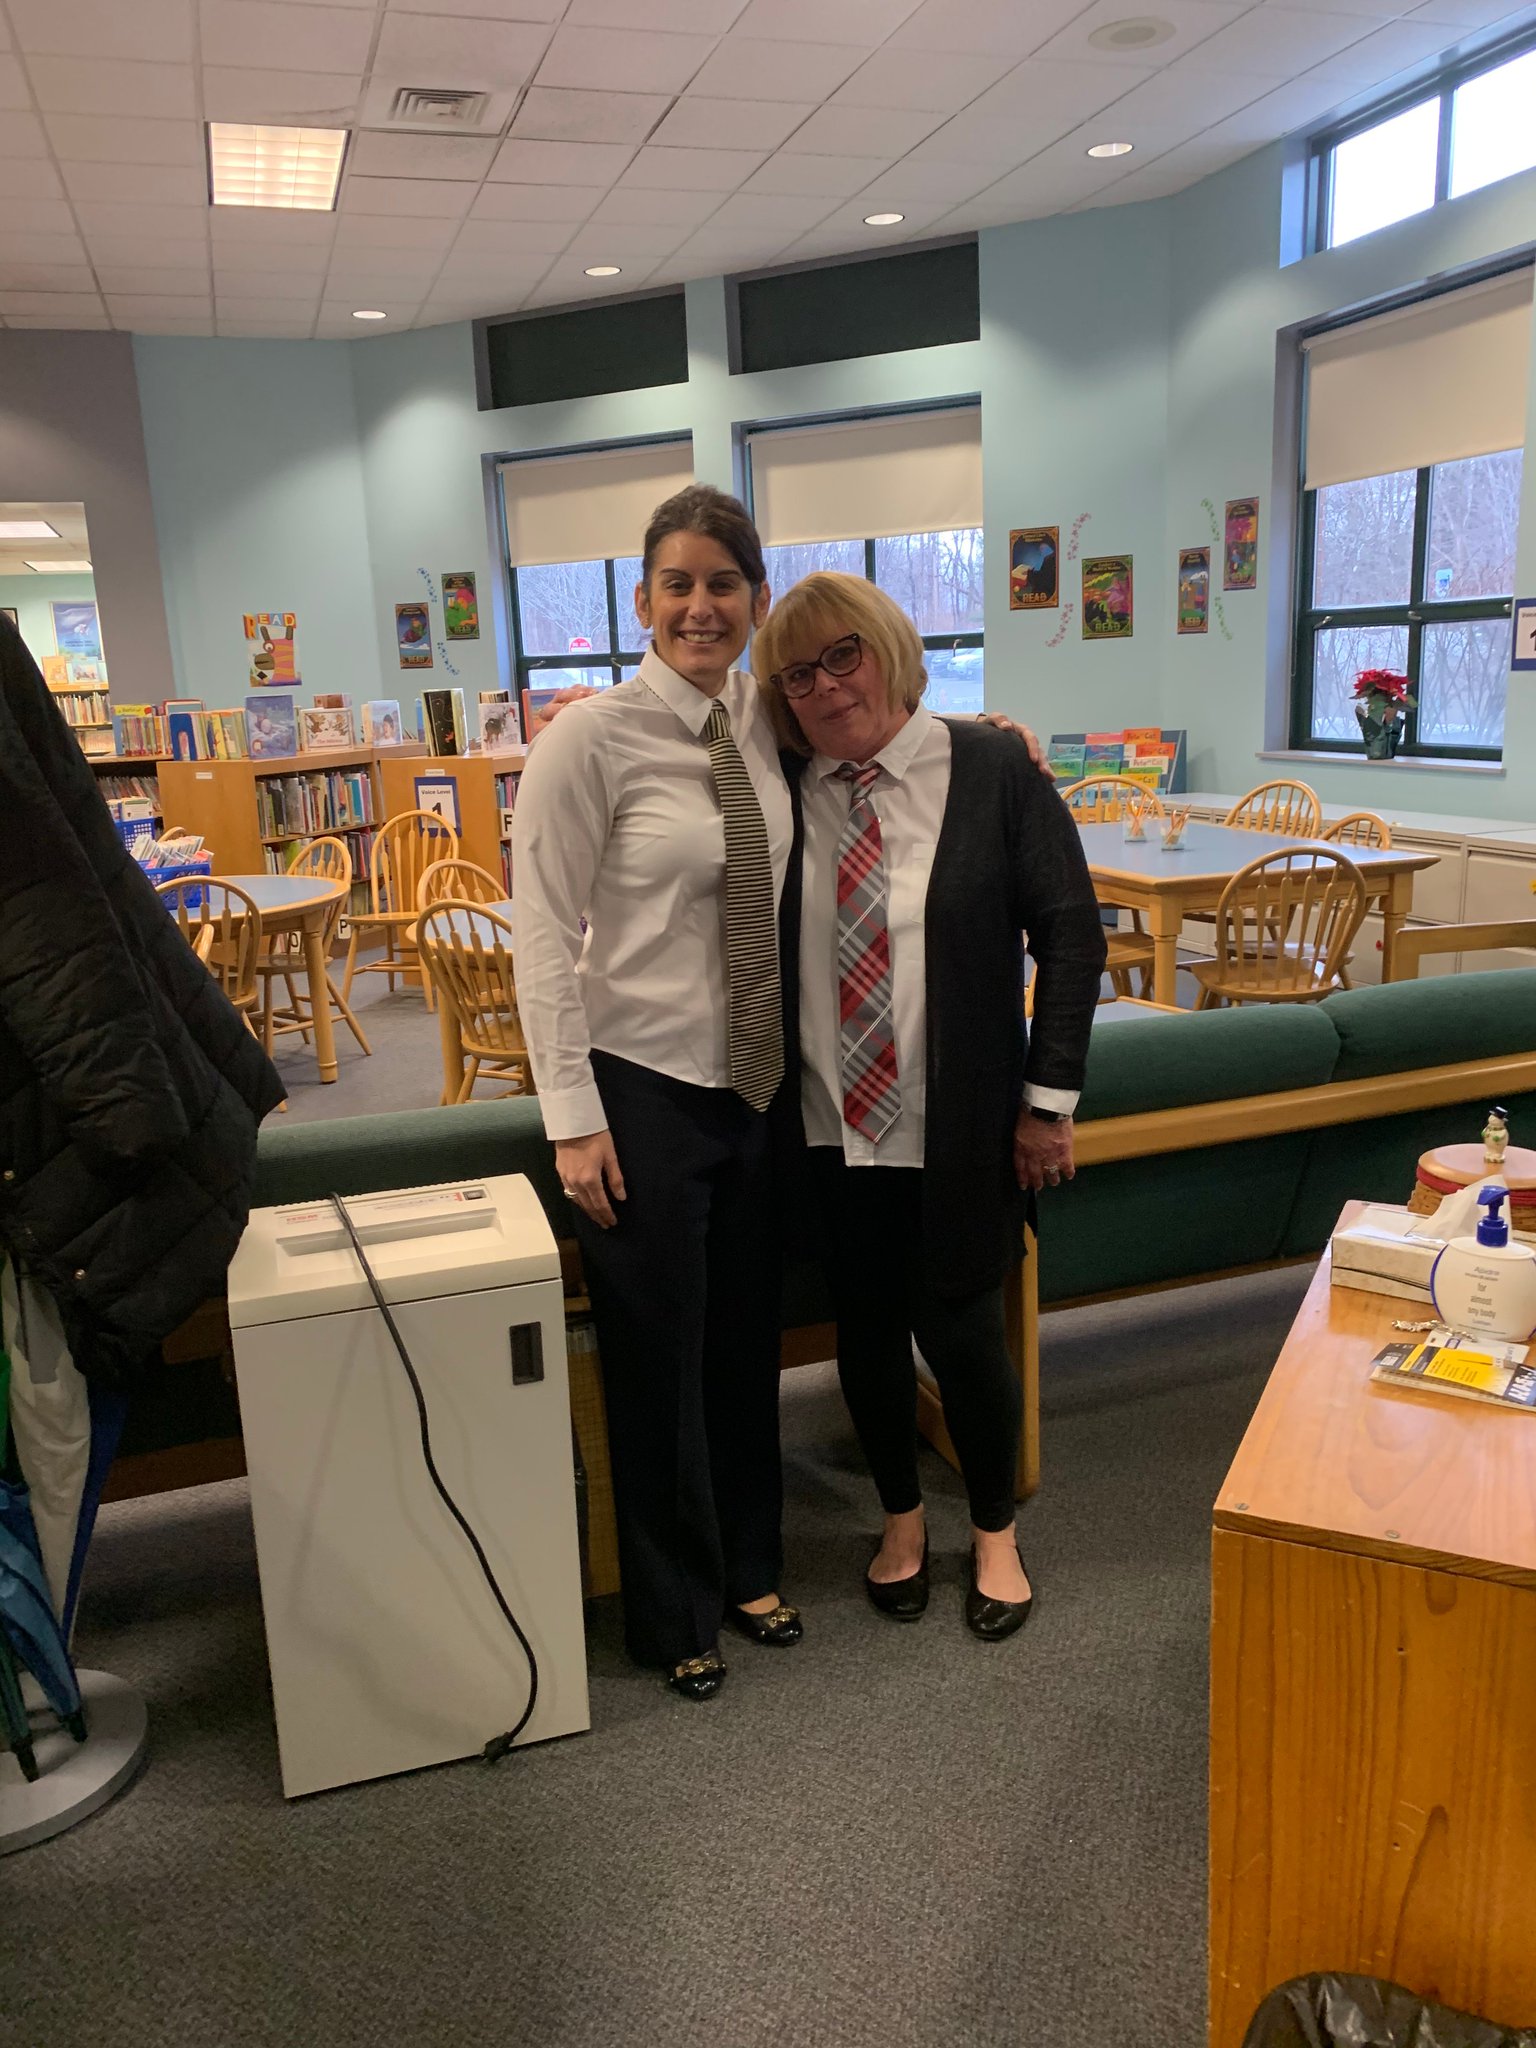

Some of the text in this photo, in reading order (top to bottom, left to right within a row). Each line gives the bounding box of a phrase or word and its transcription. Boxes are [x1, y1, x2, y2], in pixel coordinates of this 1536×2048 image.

[1022, 592, 1048, 603] READ
[243, 613, 295, 639] READ
[1095, 622, 1121, 633] READ
[432, 802, 442, 816] 1
[503, 814, 513, 832] F
[340, 919, 348, 934] P
[1477, 1282, 1487, 1292] for
